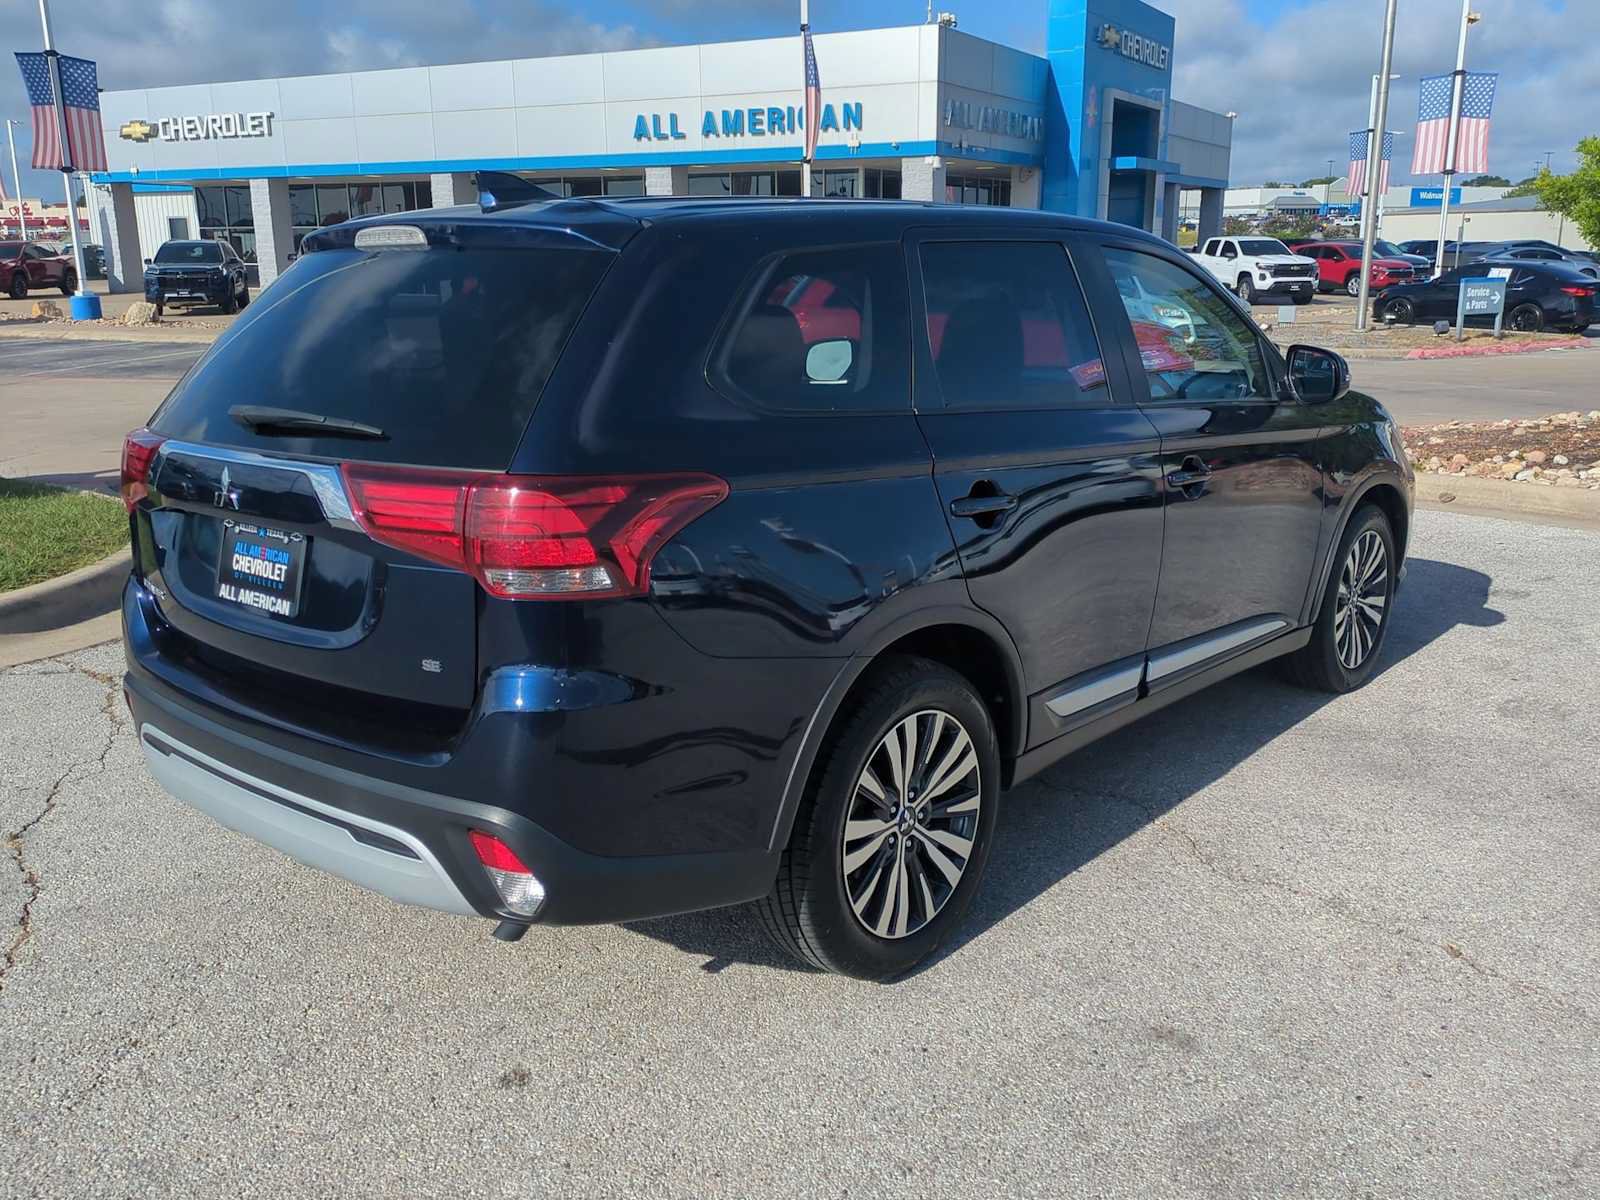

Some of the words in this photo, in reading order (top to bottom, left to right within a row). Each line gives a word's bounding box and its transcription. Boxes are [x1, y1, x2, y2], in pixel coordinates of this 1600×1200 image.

[1121, 29, 1169, 71] CHEVROLET
[158, 111, 274, 142] CHEVROLET
[633, 112, 686, 141] ALL
[1466, 287, 1490, 297] Service
[1471, 300, 1488, 310] Parts
[232, 553, 287, 582] CHEVROLET
[235, 542, 248, 555] ALL
[249, 544, 289, 564] AMERICAN
[219, 583, 237, 601] ALL
[238, 588, 290, 616] AMERICAN
